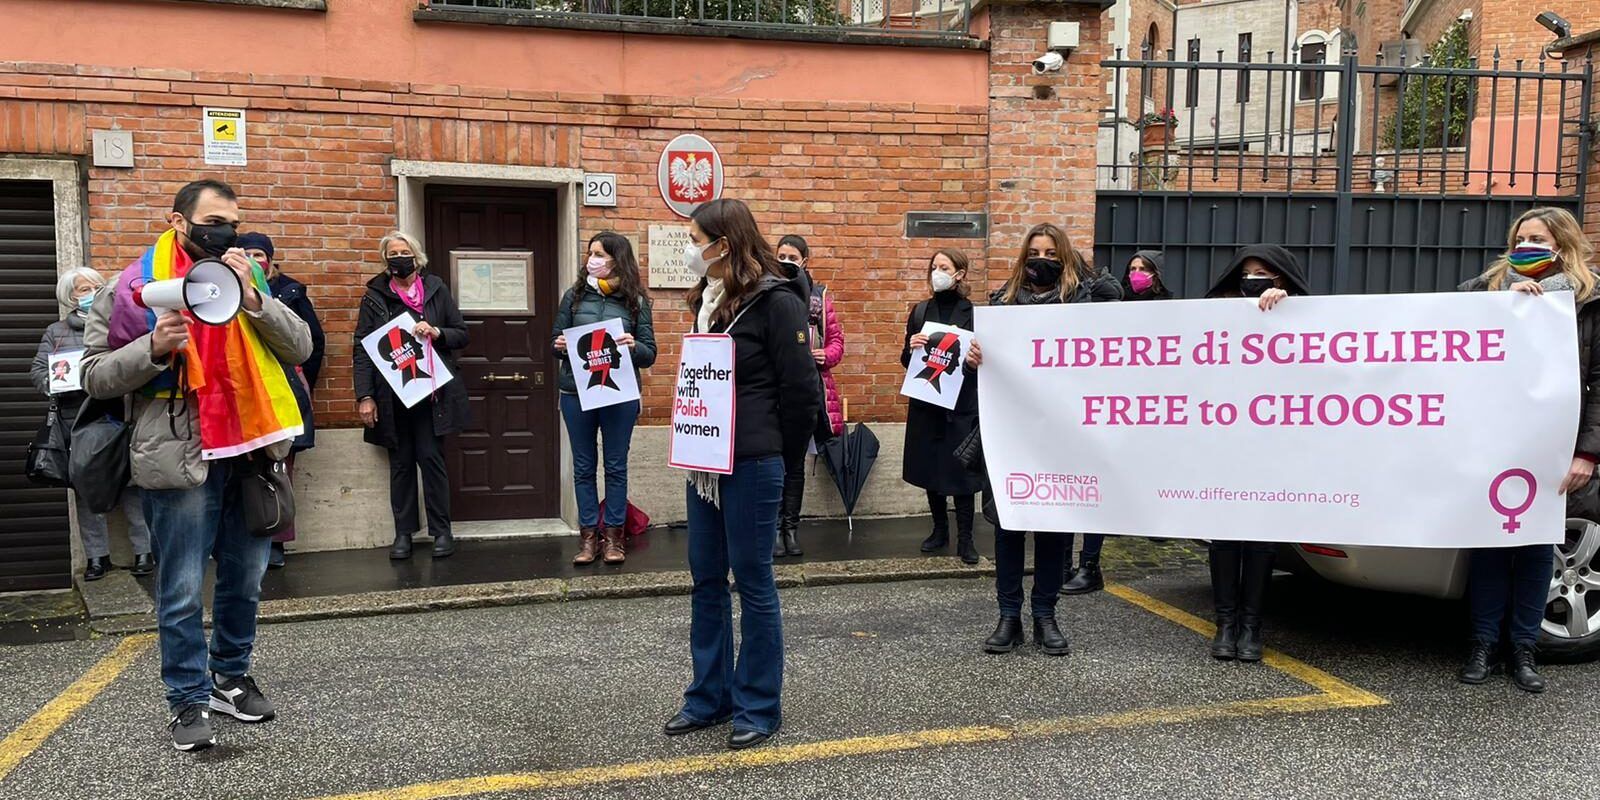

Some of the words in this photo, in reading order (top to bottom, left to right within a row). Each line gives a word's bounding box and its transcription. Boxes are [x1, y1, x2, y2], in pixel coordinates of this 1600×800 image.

[587, 181, 612, 197] 20
[389, 342, 412, 359] STRAJK
[586, 347, 611, 359] STRAJK
[930, 347, 954, 360] STRAJK
[1031, 335, 1182, 368] LIBERE
[1192, 330, 1230, 365] di
[1241, 329, 1506, 365] SCEGLIERE
[394, 349, 416, 366] KOBIET
[588, 355, 612, 366] KOBIET
[928, 355, 951, 367] KOBIET
[680, 362, 732, 383] Together
[677, 380, 700, 398] with
[675, 398, 708, 417] Polish
[1082, 395, 1189, 426] FREE
[1198, 400, 1238, 426] to
[1248, 394, 1446, 426] CHOOSE
[674, 422, 720, 437] women
[1157, 487, 1360, 508] www.differenzadonna.org
